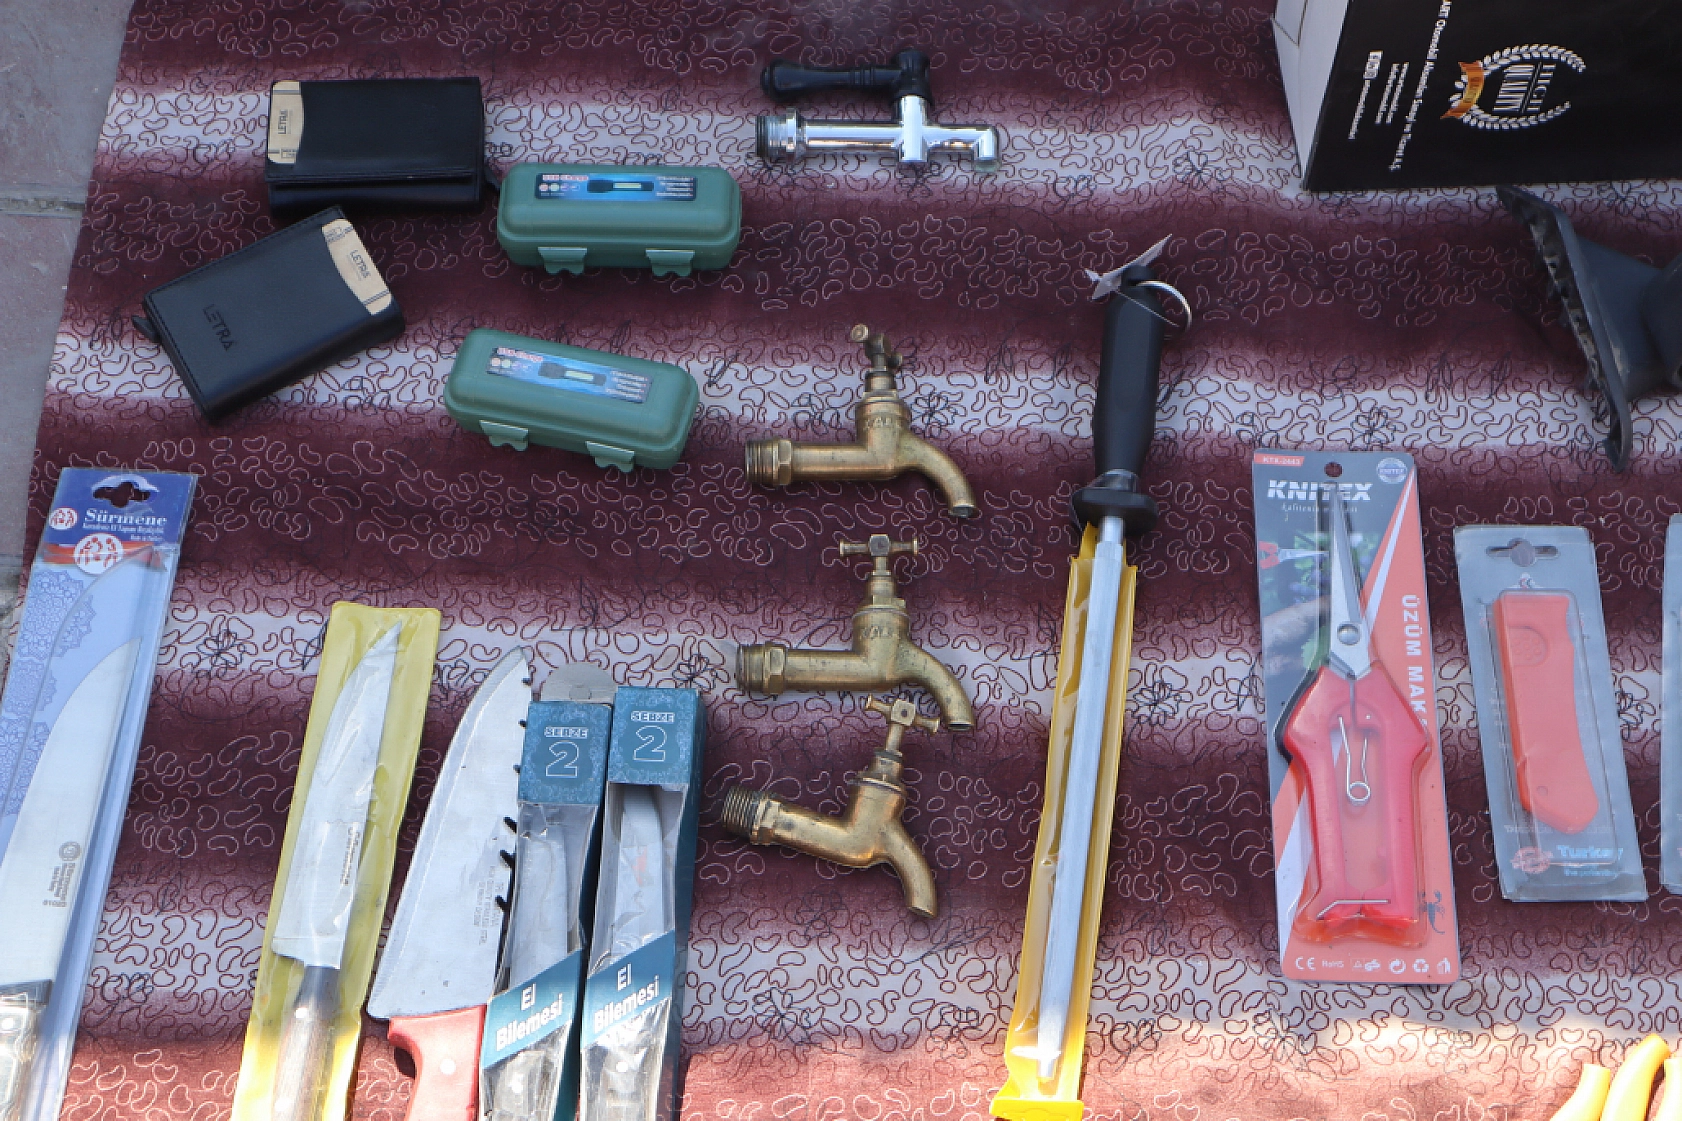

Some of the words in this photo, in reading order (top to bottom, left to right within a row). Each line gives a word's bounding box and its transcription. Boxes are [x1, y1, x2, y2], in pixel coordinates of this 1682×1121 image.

[277, 109, 288, 135] LETRA
[350, 249, 371, 279] LETRA
[202, 303, 237, 352] LETRA
[1267, 479, 1374, 501] KNITEX
[84, 507, 168, 527] Sürmene
[1401, 594, 1424, 657] ÜZÜM
[545, 740, 580, 779] 2
[633, 725, 666, 762] 2
[617, 961, 633, 992] El
[520, 982, 537, 1012] El
[594, 973, 661, 1034] Bilemesi
[496, 992, 564, 1052] Bilemesi
